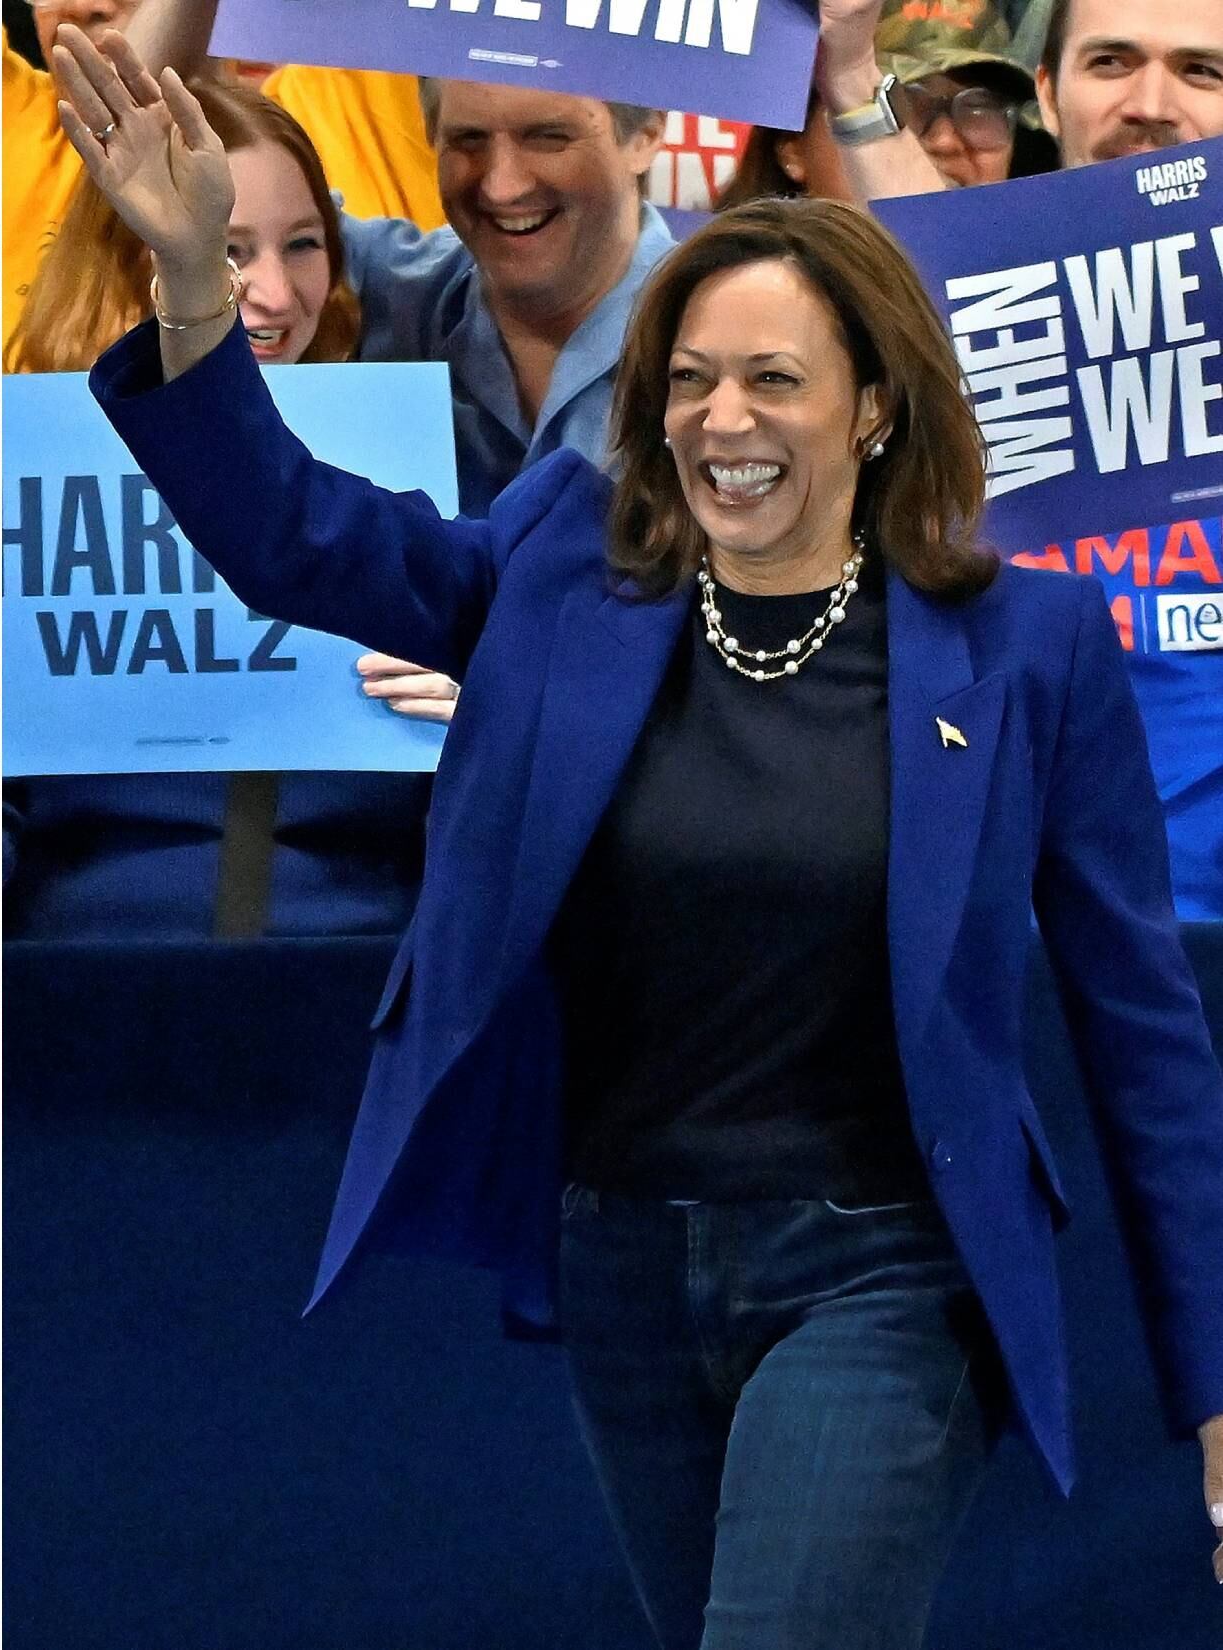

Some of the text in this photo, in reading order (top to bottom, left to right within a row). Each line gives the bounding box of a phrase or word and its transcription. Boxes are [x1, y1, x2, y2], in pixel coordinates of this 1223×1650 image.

[1136, 156, 1208, 194] HARRIS
[1148, 181, 1200, 206] WALZ
[1063, 232, 1206, 359] WE
[945, 261, 1076, 501] WHEN
[1076, 340, 1223, 474] WE
[1, 474, 215, 597] HAR
[36, 609, 297, 677] WALZ
